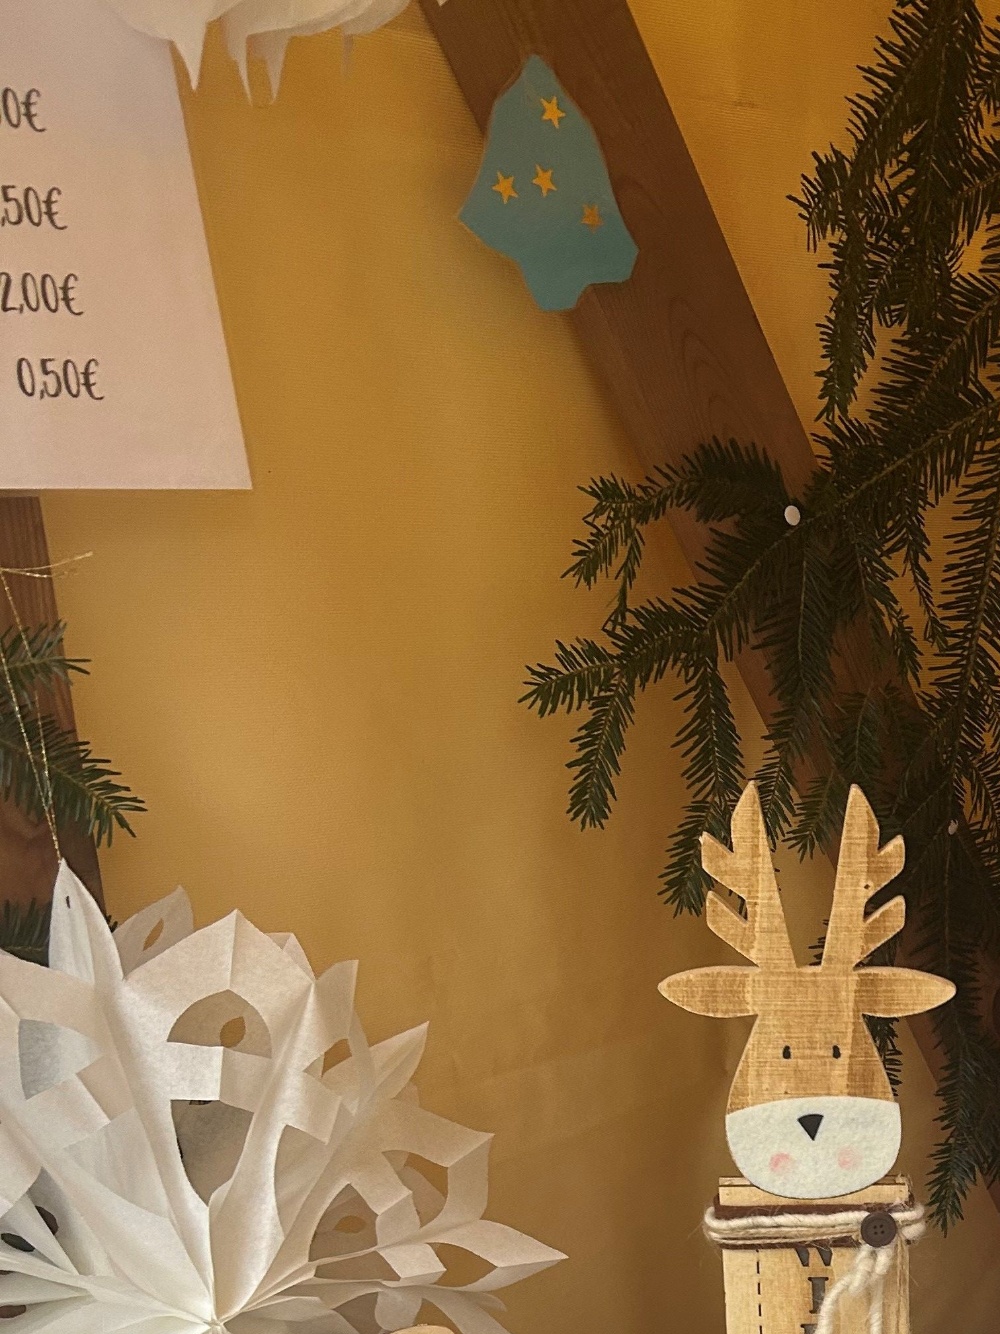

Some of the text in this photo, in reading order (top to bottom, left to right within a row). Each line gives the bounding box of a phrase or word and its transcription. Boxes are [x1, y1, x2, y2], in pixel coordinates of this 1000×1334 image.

[0, 87, 46, 132] 0€
[0, 272, 84, 315] 2,00€
[17, 357, 104, 400] 0,50€
